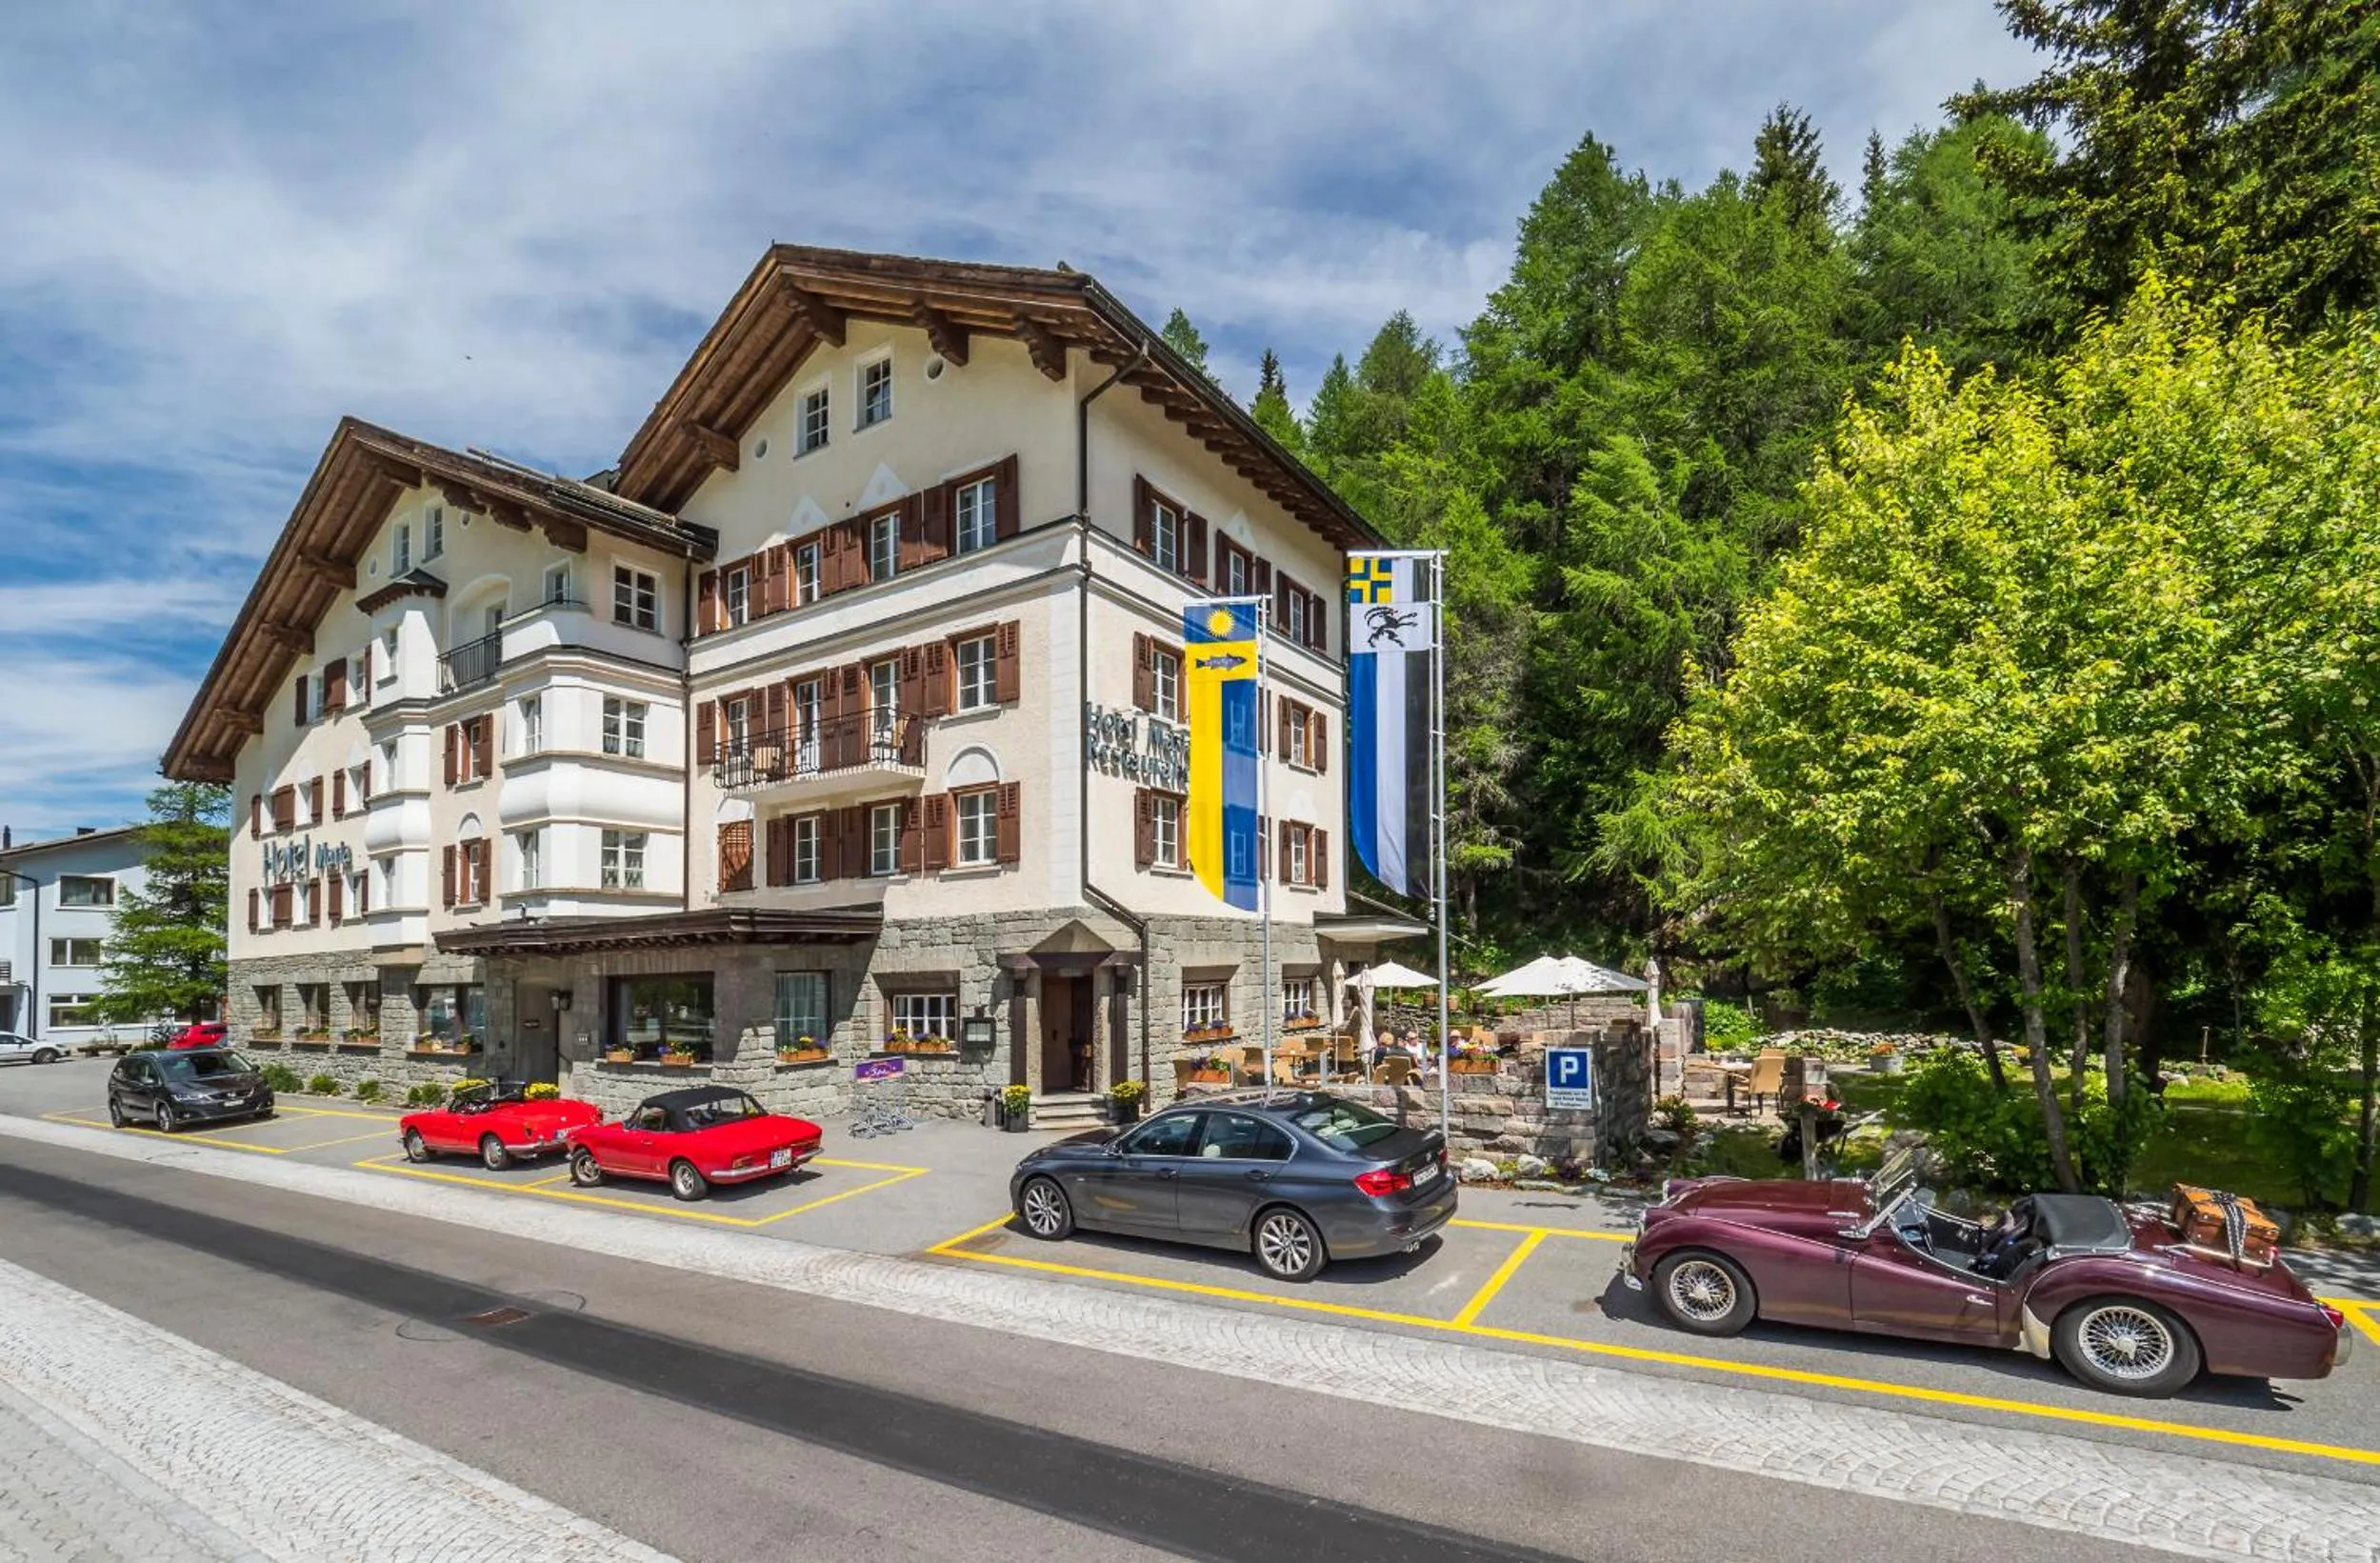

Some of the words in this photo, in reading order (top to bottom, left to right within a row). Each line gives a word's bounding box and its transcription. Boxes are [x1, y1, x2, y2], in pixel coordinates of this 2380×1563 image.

[1087, 702, 1138, 741] Hotel
[264, 833, 310, 880] Hotel
[315, 841, 352, 870] Maria
[1560, 1056, 1579, 1084] P
